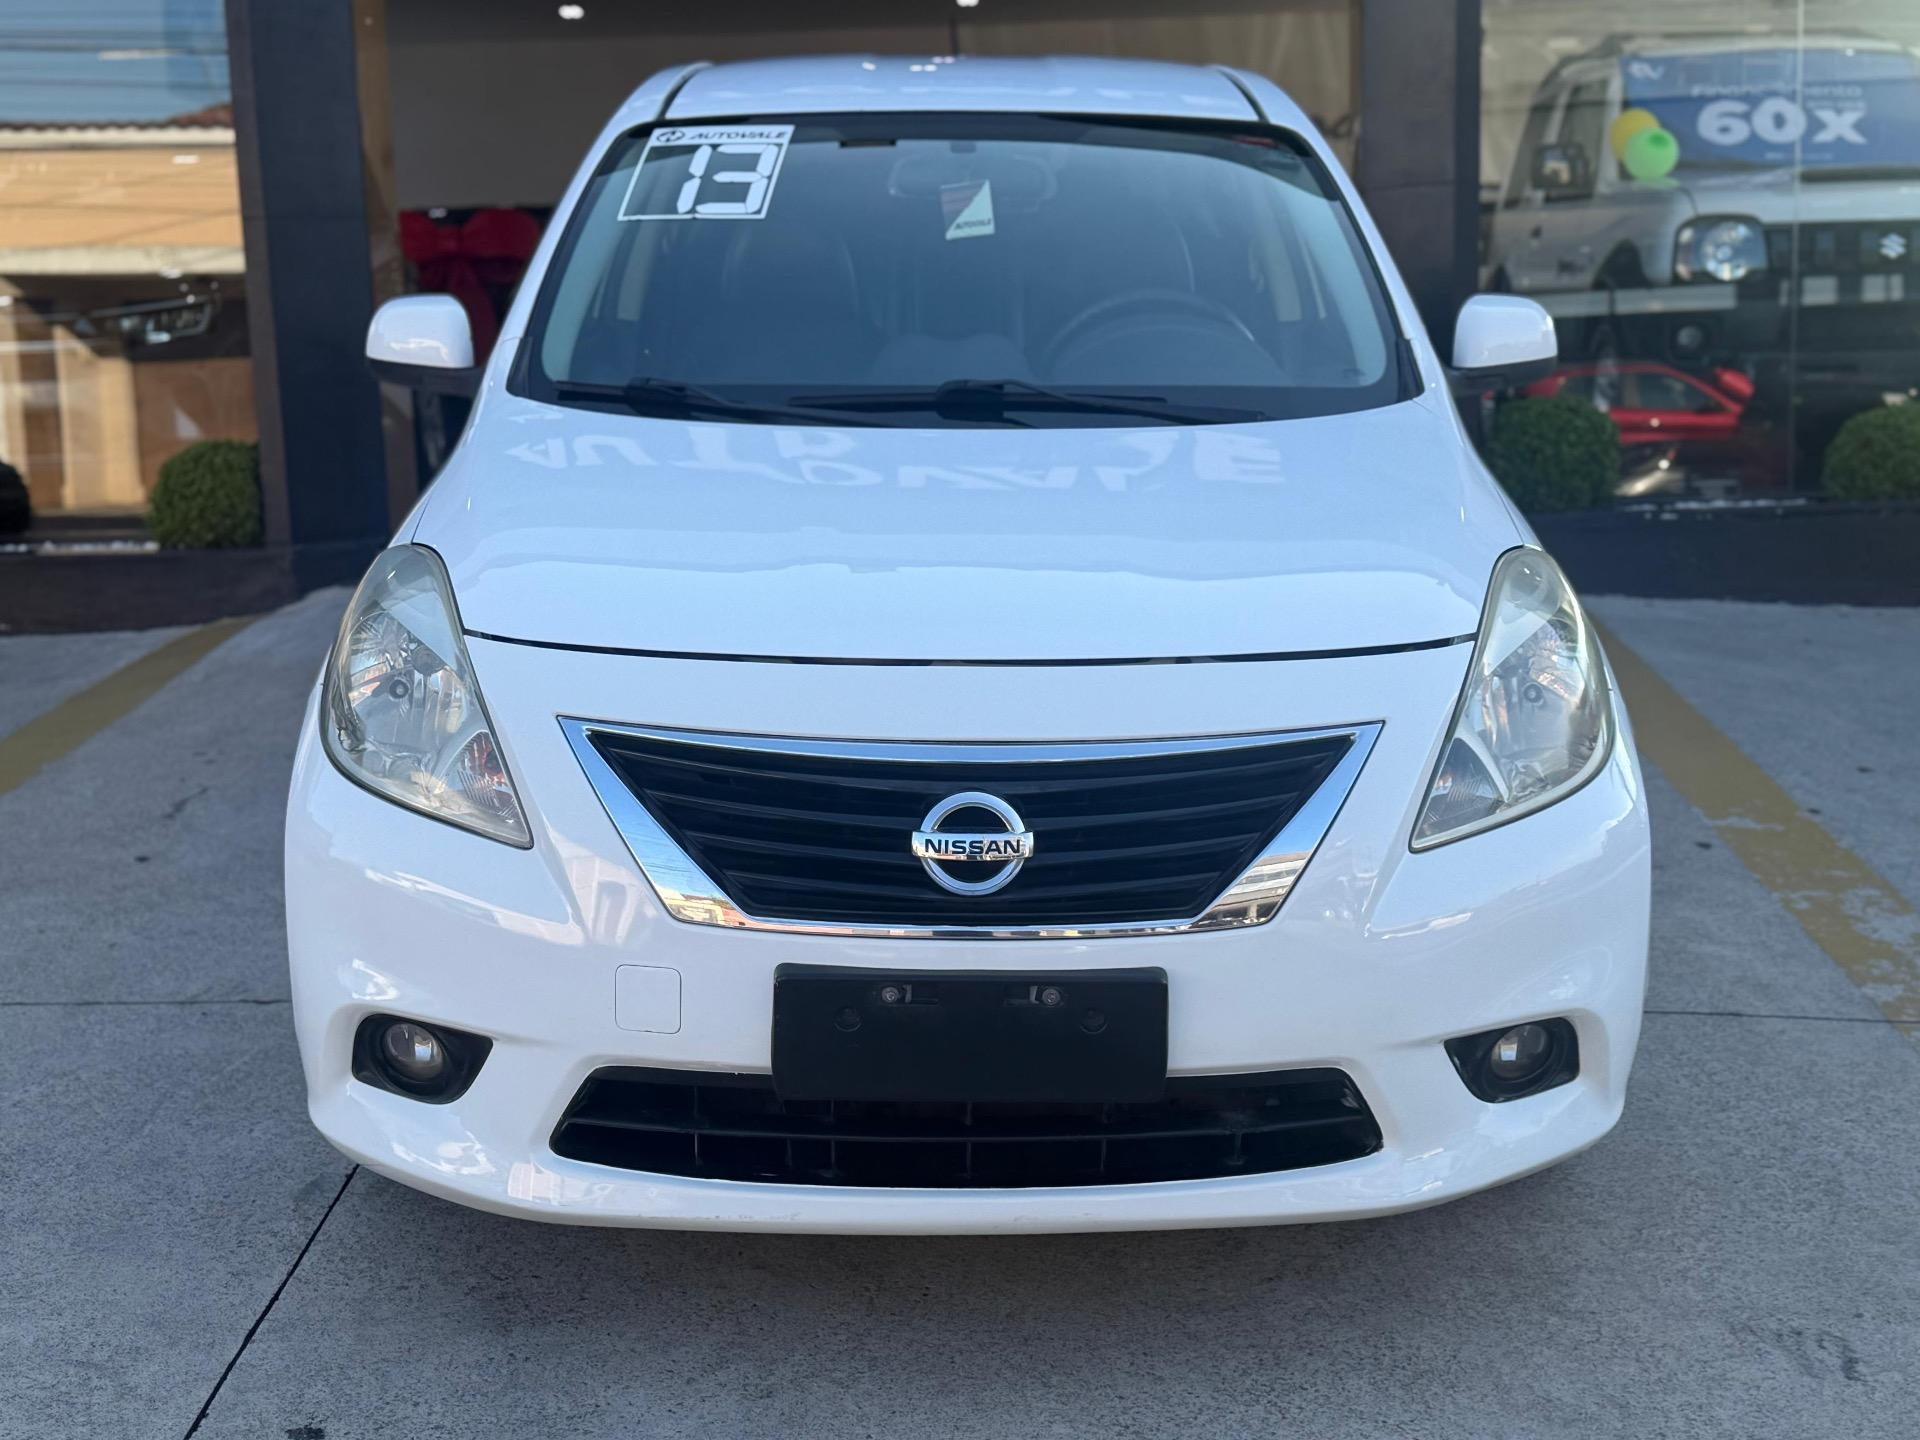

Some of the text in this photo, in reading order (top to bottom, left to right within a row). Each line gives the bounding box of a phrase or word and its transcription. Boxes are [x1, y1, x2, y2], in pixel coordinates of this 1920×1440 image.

[690, 131, 786, 140] AUTOVALE
[676, 144, 779, 214] 13
[925, 838, 1021, 855] NISSAN
